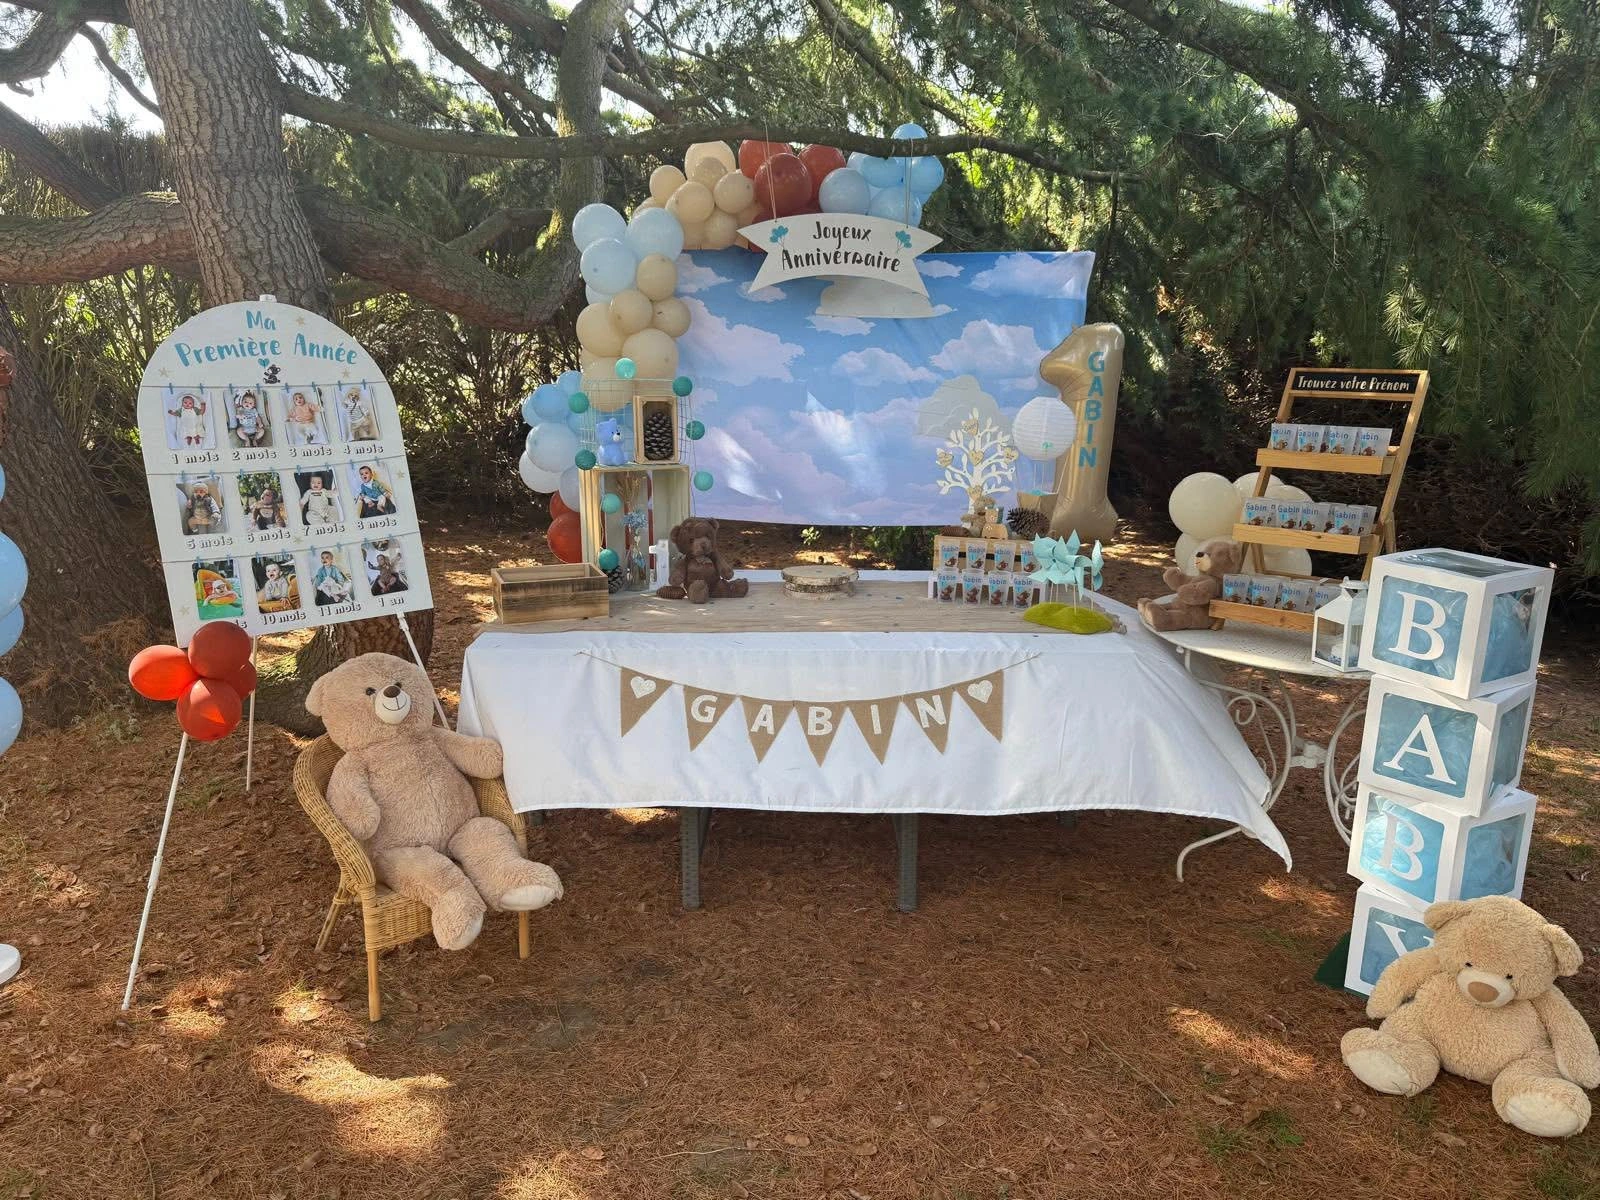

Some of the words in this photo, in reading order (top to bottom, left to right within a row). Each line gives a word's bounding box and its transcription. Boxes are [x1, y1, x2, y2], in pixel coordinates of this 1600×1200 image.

[813, 221, 872, 249] Joyeux
[781, 248, 901, 273] Anniversaire
[245, 310, 276, 331] Ma
[174, 336, 282, 367] Première
[293, 332, 357, 365] Année
[1298, 375, 1337, 388] Trouvez
[1340, 376, 1367, 390] votre
[1369, 376, 1410, 391] Prénom
[1078, 351, 1106, 468] GABIN
[232, 450, 240, 460] 2
[245, 448, 277, 460] mois
[289, 447, 297, 457] 3
[302, 446, 332, 457] mois
[344, 444, 351, 454] 4
[356, 444, 384, 454] mois
[172, 453, 179, 464] 1
[185, 451, 220, 464] mois
[303, 526, 310, 536] 7
[315, 523, 346, 535] mois
[357, 520, 364, 530] 8
[369, 517, 398, 529] mois
[186, 538, 196, 549] 5
[200, 535, 233, 548] mois
[259, 529, 291, 542] mois
[320, 606, 331, 616] 11
[335, 602, 362, 614] mois
[378, 598, 385, 607] 1
[390, 598, 405, 606] an
[262, 615, 276, 626] 10
[279, 611, 307, 624] mois
[690, 694, 947, 736] GABIN
